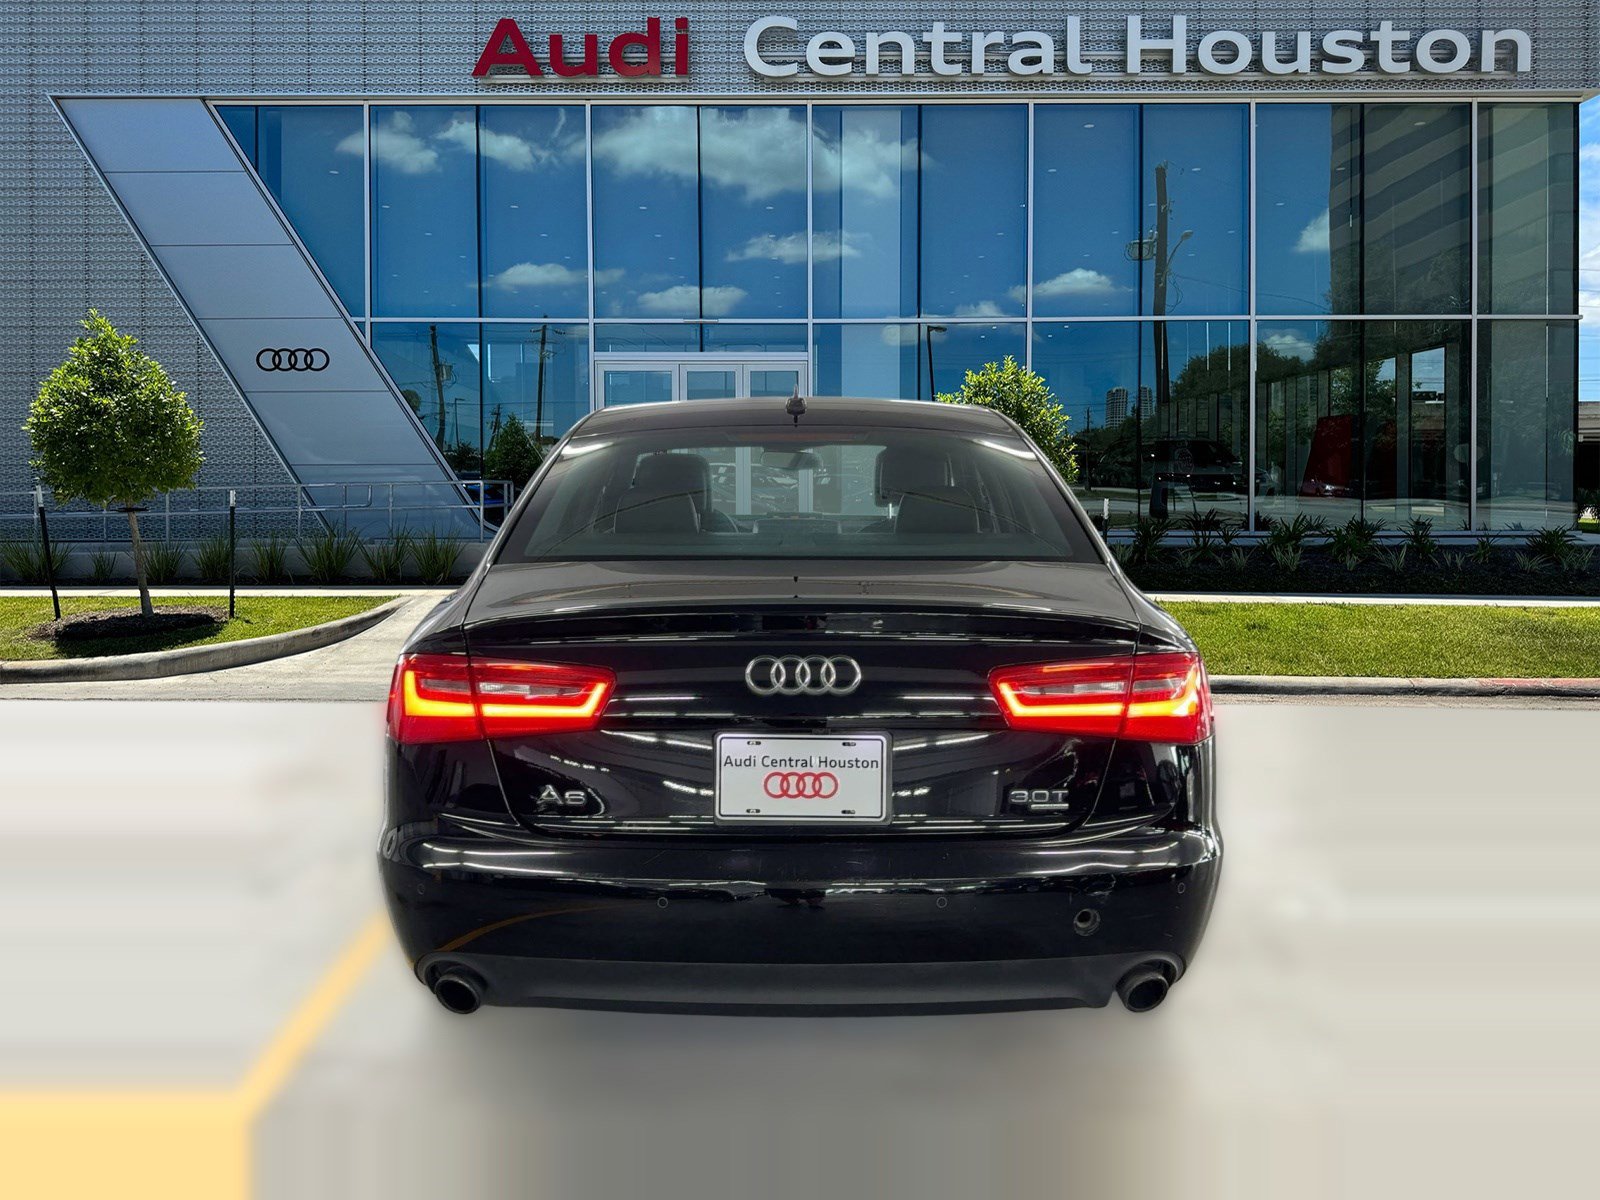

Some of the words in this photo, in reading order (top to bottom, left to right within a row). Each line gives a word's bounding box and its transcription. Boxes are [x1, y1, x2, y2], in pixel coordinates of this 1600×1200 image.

[472, 17, 690, 78] Audi
[742, 15, 1092, 78] Central
[1126, 15, 1533, 75] Houston
[723, 755, 757, 768] Audi
[761, 755, 814, 768] Central
[818, 756, 879, 769] Houston
[536, 784, 585, 805] A6
[1010, 790, 1069, 802] 3.0T
